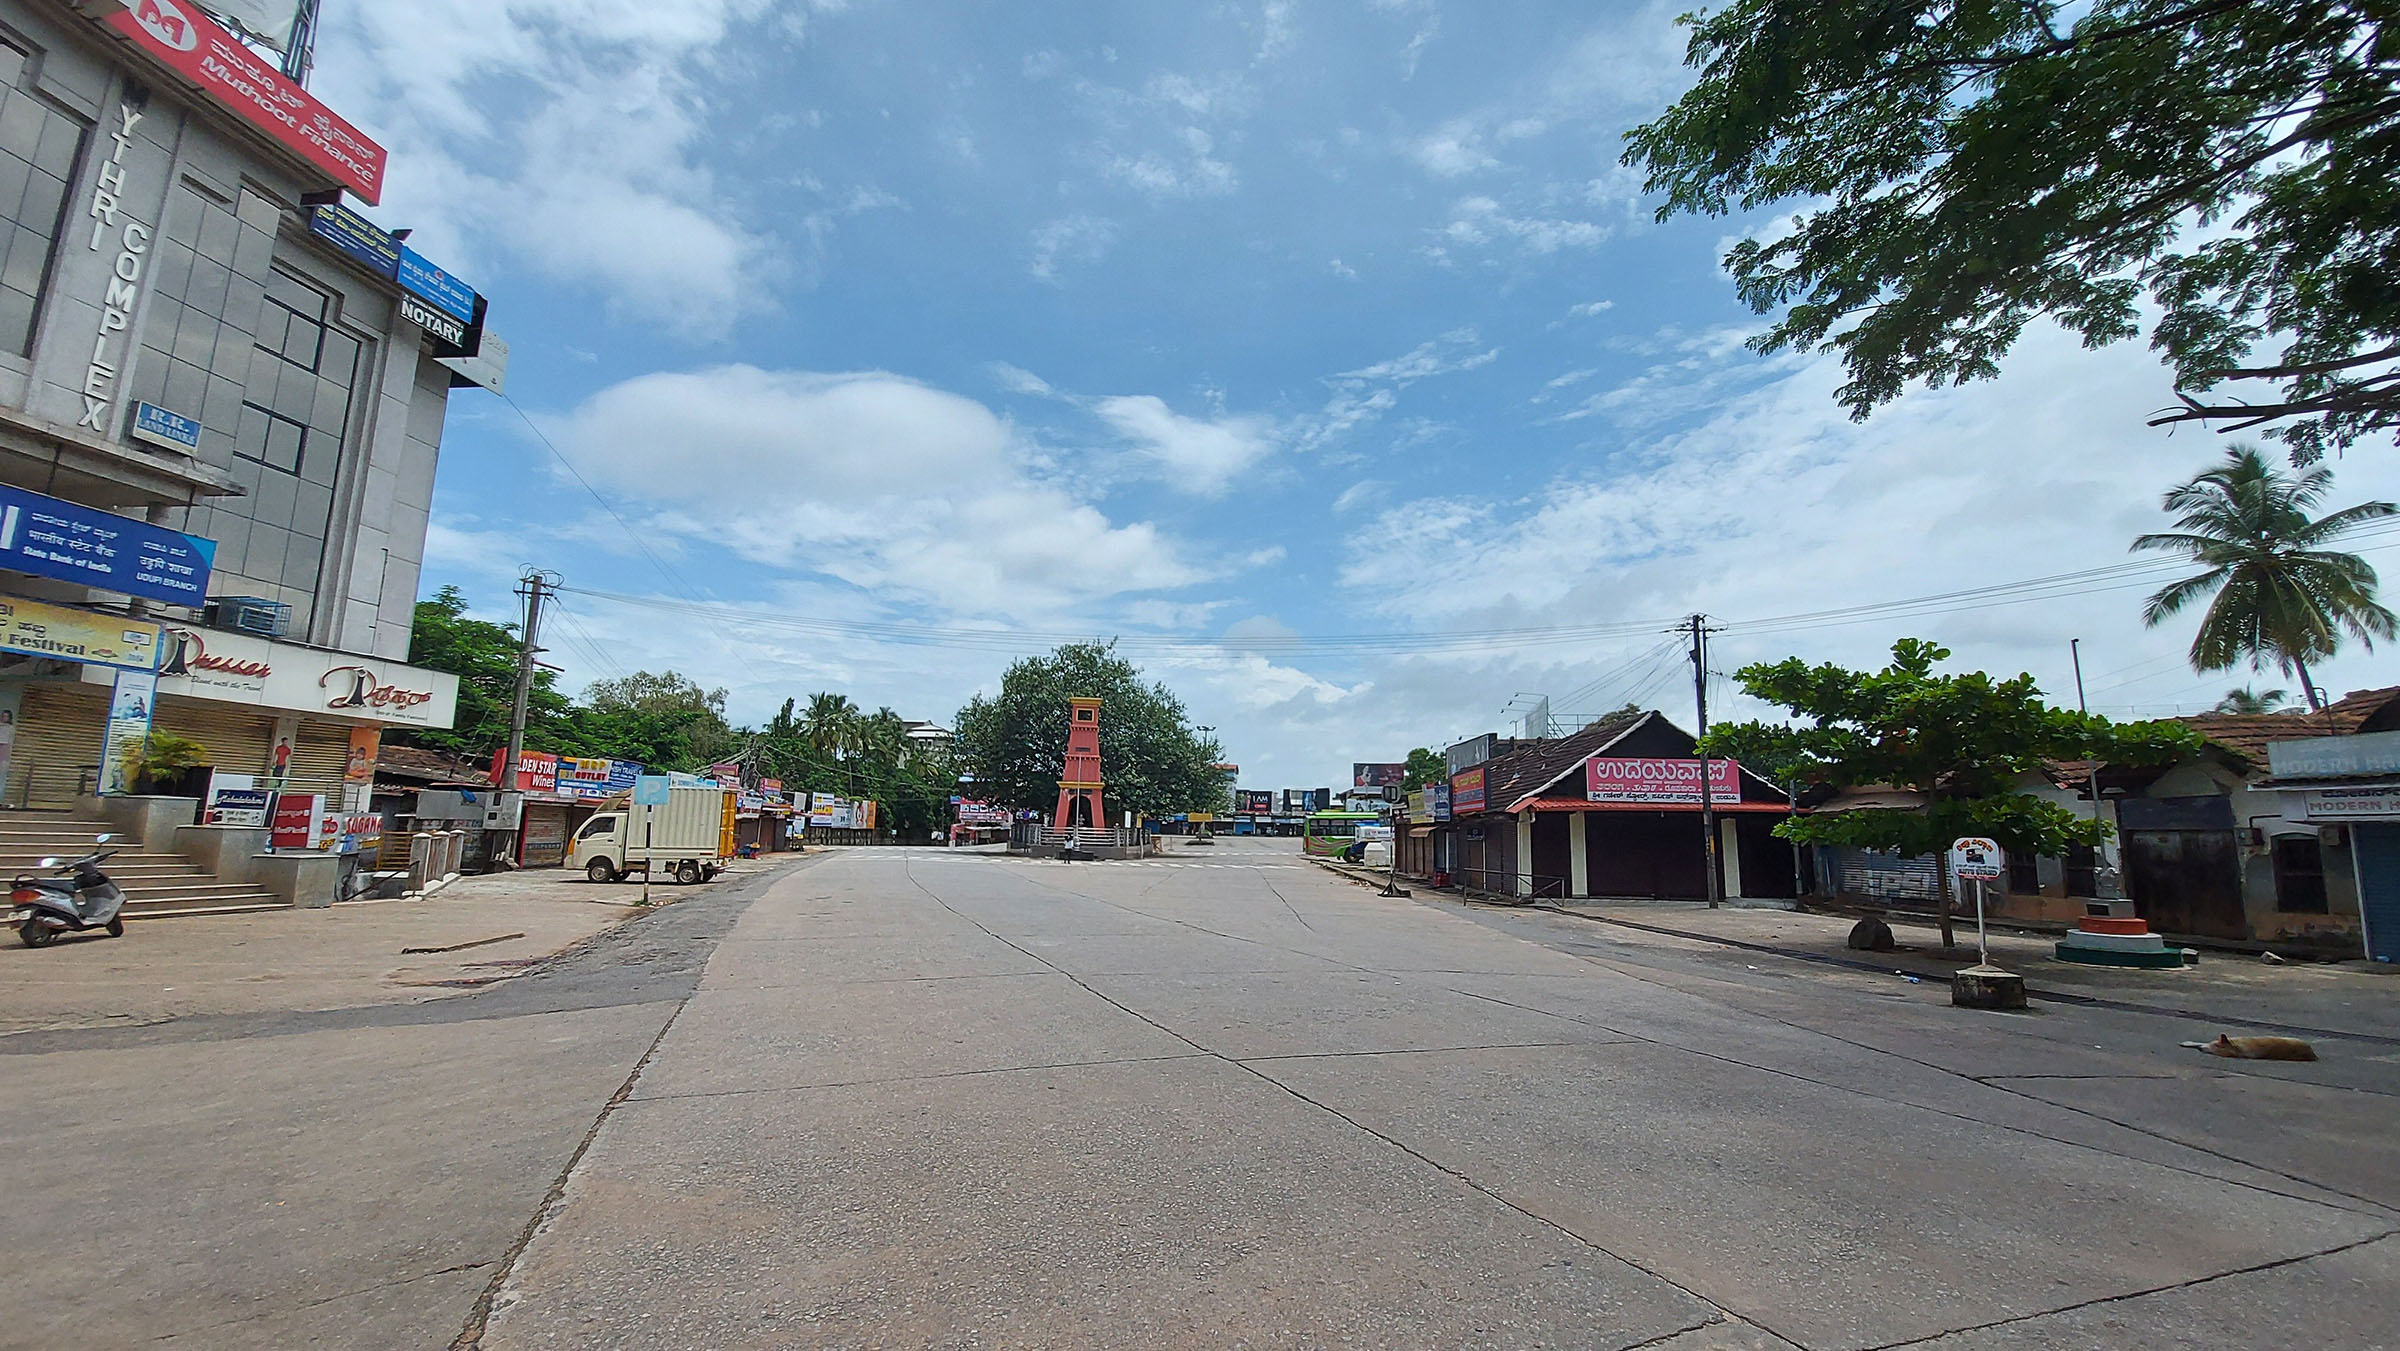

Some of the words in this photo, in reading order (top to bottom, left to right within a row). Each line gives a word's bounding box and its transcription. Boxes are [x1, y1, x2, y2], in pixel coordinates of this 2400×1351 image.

[201, 56, 297, 129] Muthoot
[298, 124, 374, 182] Finance
[78, 223, 148, 432] COMPLEX
[401, 300, 464, 343] NOTARY
[137, 417, 164, 434] LAND
[165, 427, 196, 446] LINKS
[150, 408, 190, 433] R.R.
[28, 528, 67, 547] भारतीय
[67, 537, 94, 553] स्टेट
[95, 542, 118, 559] बैंक
[23, 546, 48, 560] State
[49, 551, 74, 566] Bank
[75, 557, 87, 568] of
[87, 560, 113, 574] India
[167, 561, 194, 577] शाखा
[136, 571, 163, 586] UDUPI
[162, 577, 198, 592] BRANCH
[8, 633, 86, 656] Festival
[518, 758, 539, 773] LDEN
[538, 760, 557, 776] STAR
[575, 771, 607, 781] OUTLET
[532, 773, 556, 788] Wines
[643, 780, 661, 799] P
[2309, 801, 2382, 811] MODERN
[345, 816, 384, 835] SUGAMA
